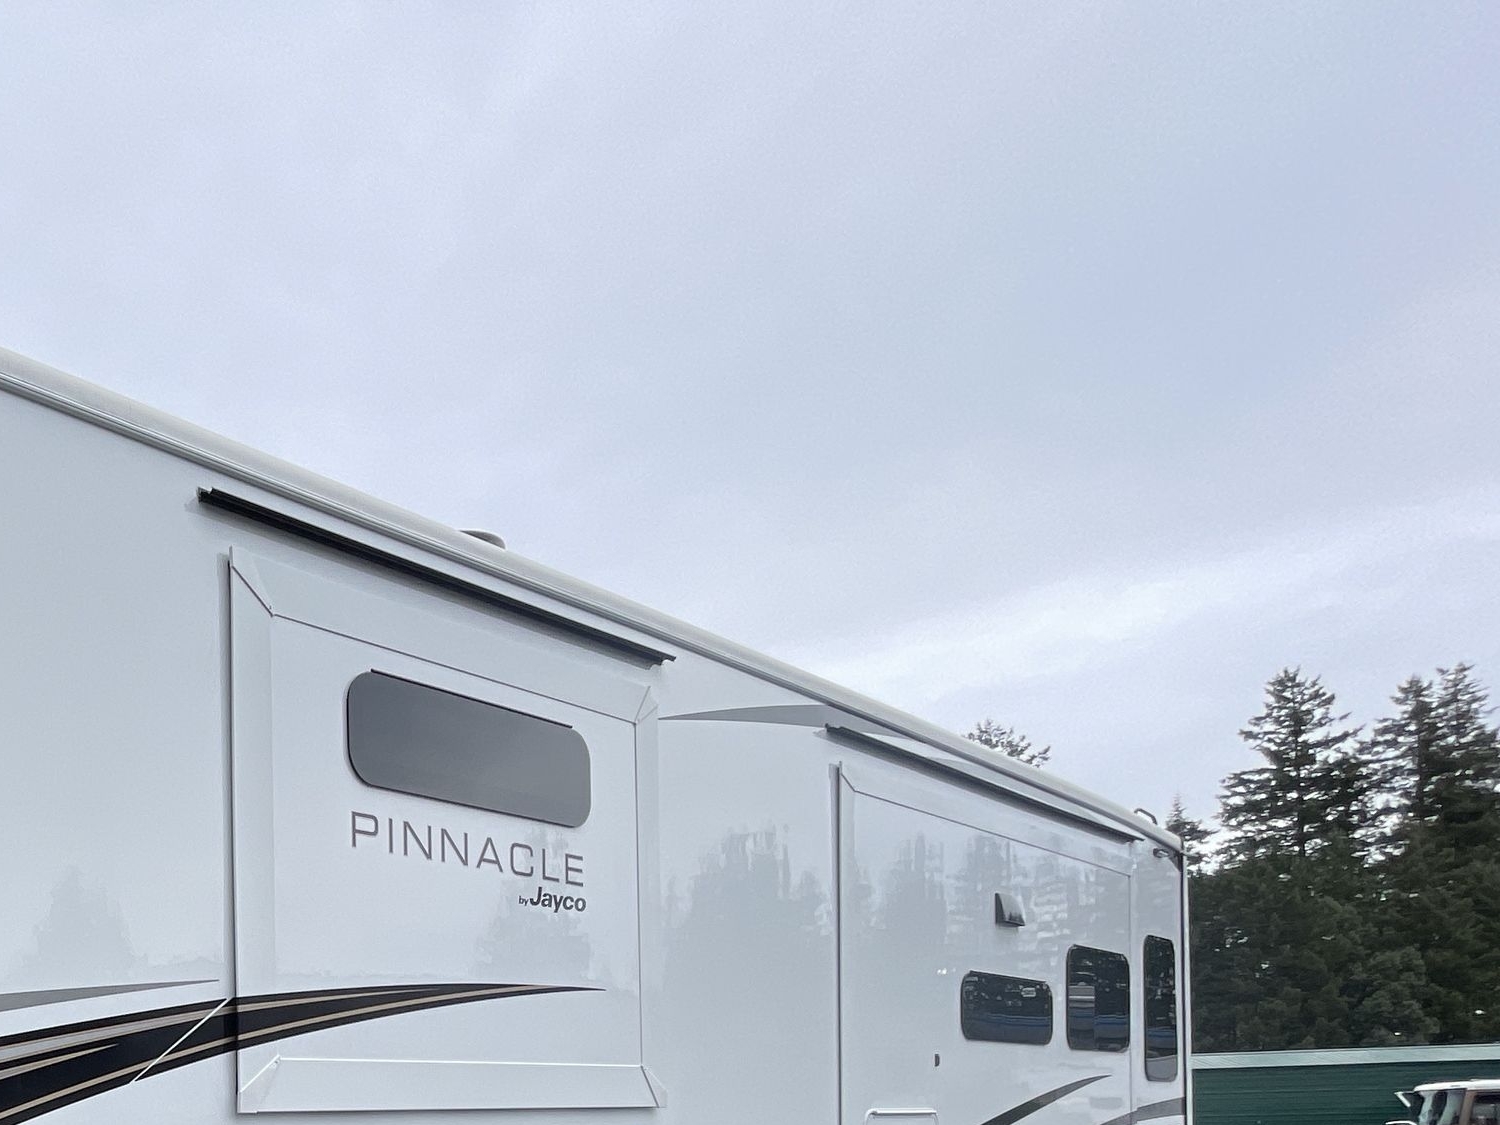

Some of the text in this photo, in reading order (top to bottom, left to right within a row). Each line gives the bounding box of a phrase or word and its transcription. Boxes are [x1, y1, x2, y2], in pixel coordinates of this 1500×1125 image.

[350, 811, 584, 887] PINNACLE
[518, 886, 587, 913] by Jayco
